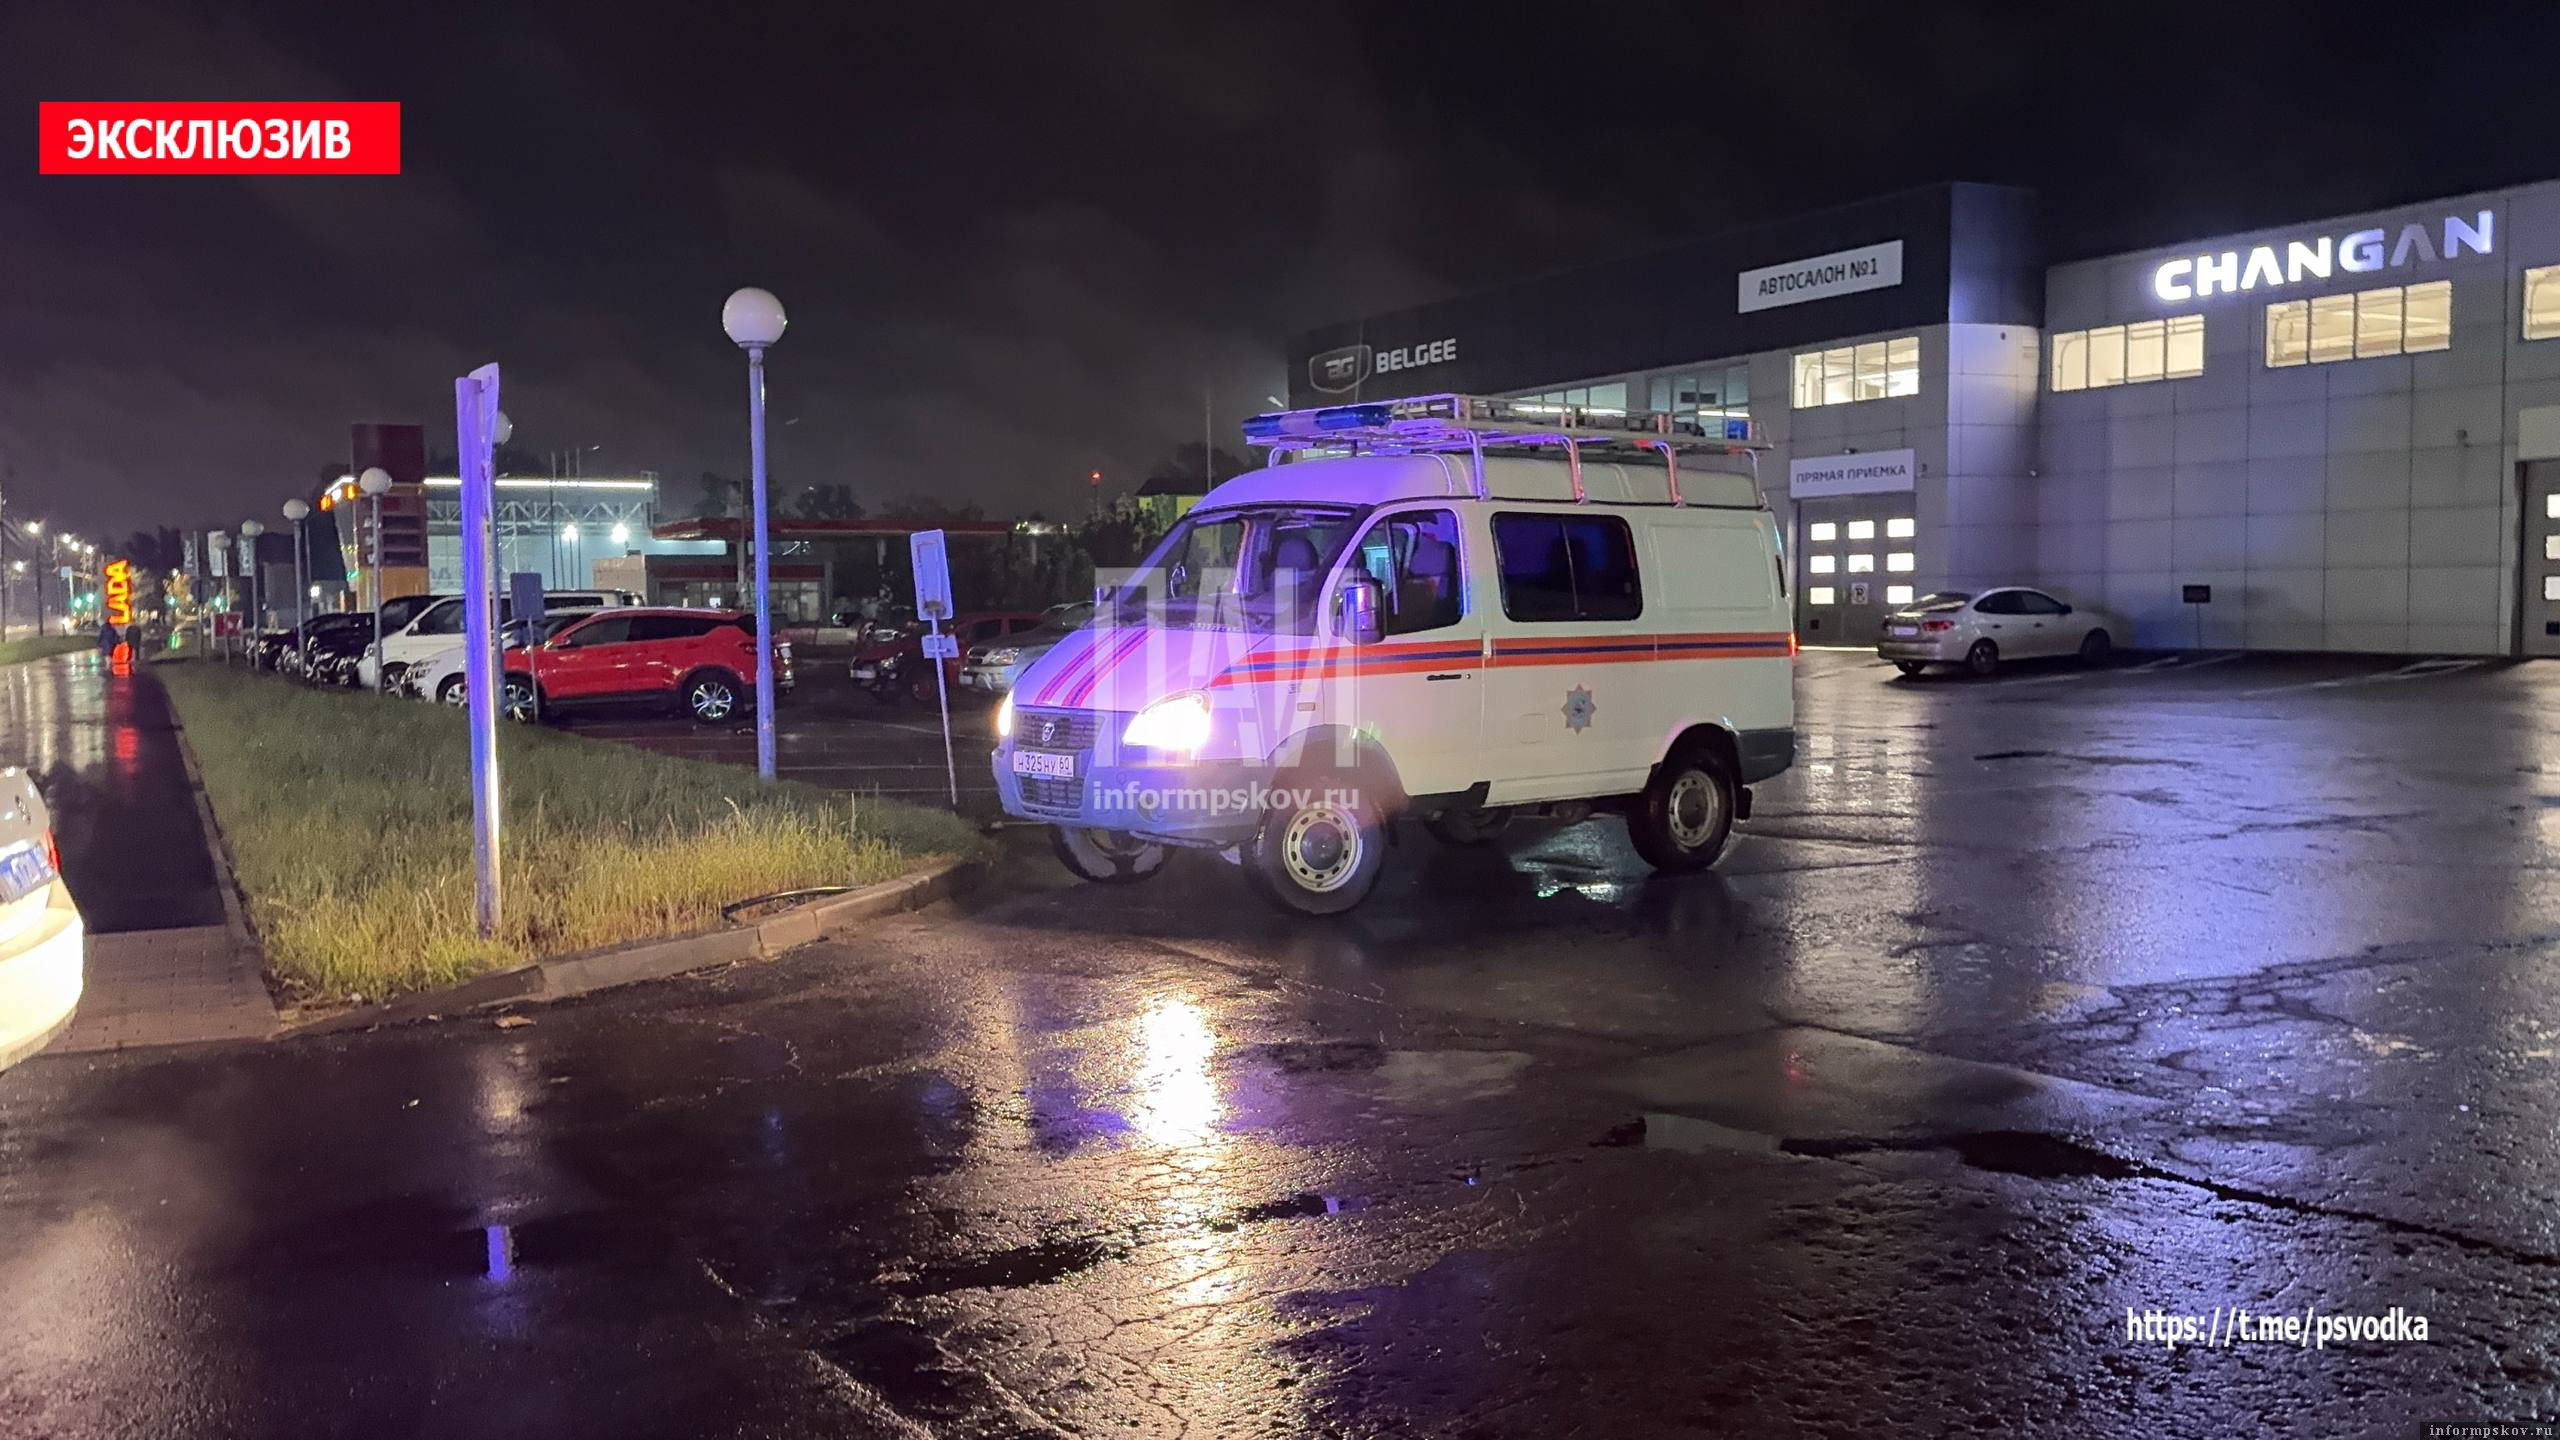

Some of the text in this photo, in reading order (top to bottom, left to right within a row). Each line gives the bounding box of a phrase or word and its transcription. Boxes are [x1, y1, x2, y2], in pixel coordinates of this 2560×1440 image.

[2154, 210, 2494, 302] CHANGAN
[1758, 257, 1878, 297] АВТОСАЛОН №1
[1376, 338, 1457, 374] BELGEE
[1796, 465, 1906, 483] ПРЯМАЯ ПРИЕМКА
[105, 559, 131, 625] LADA
